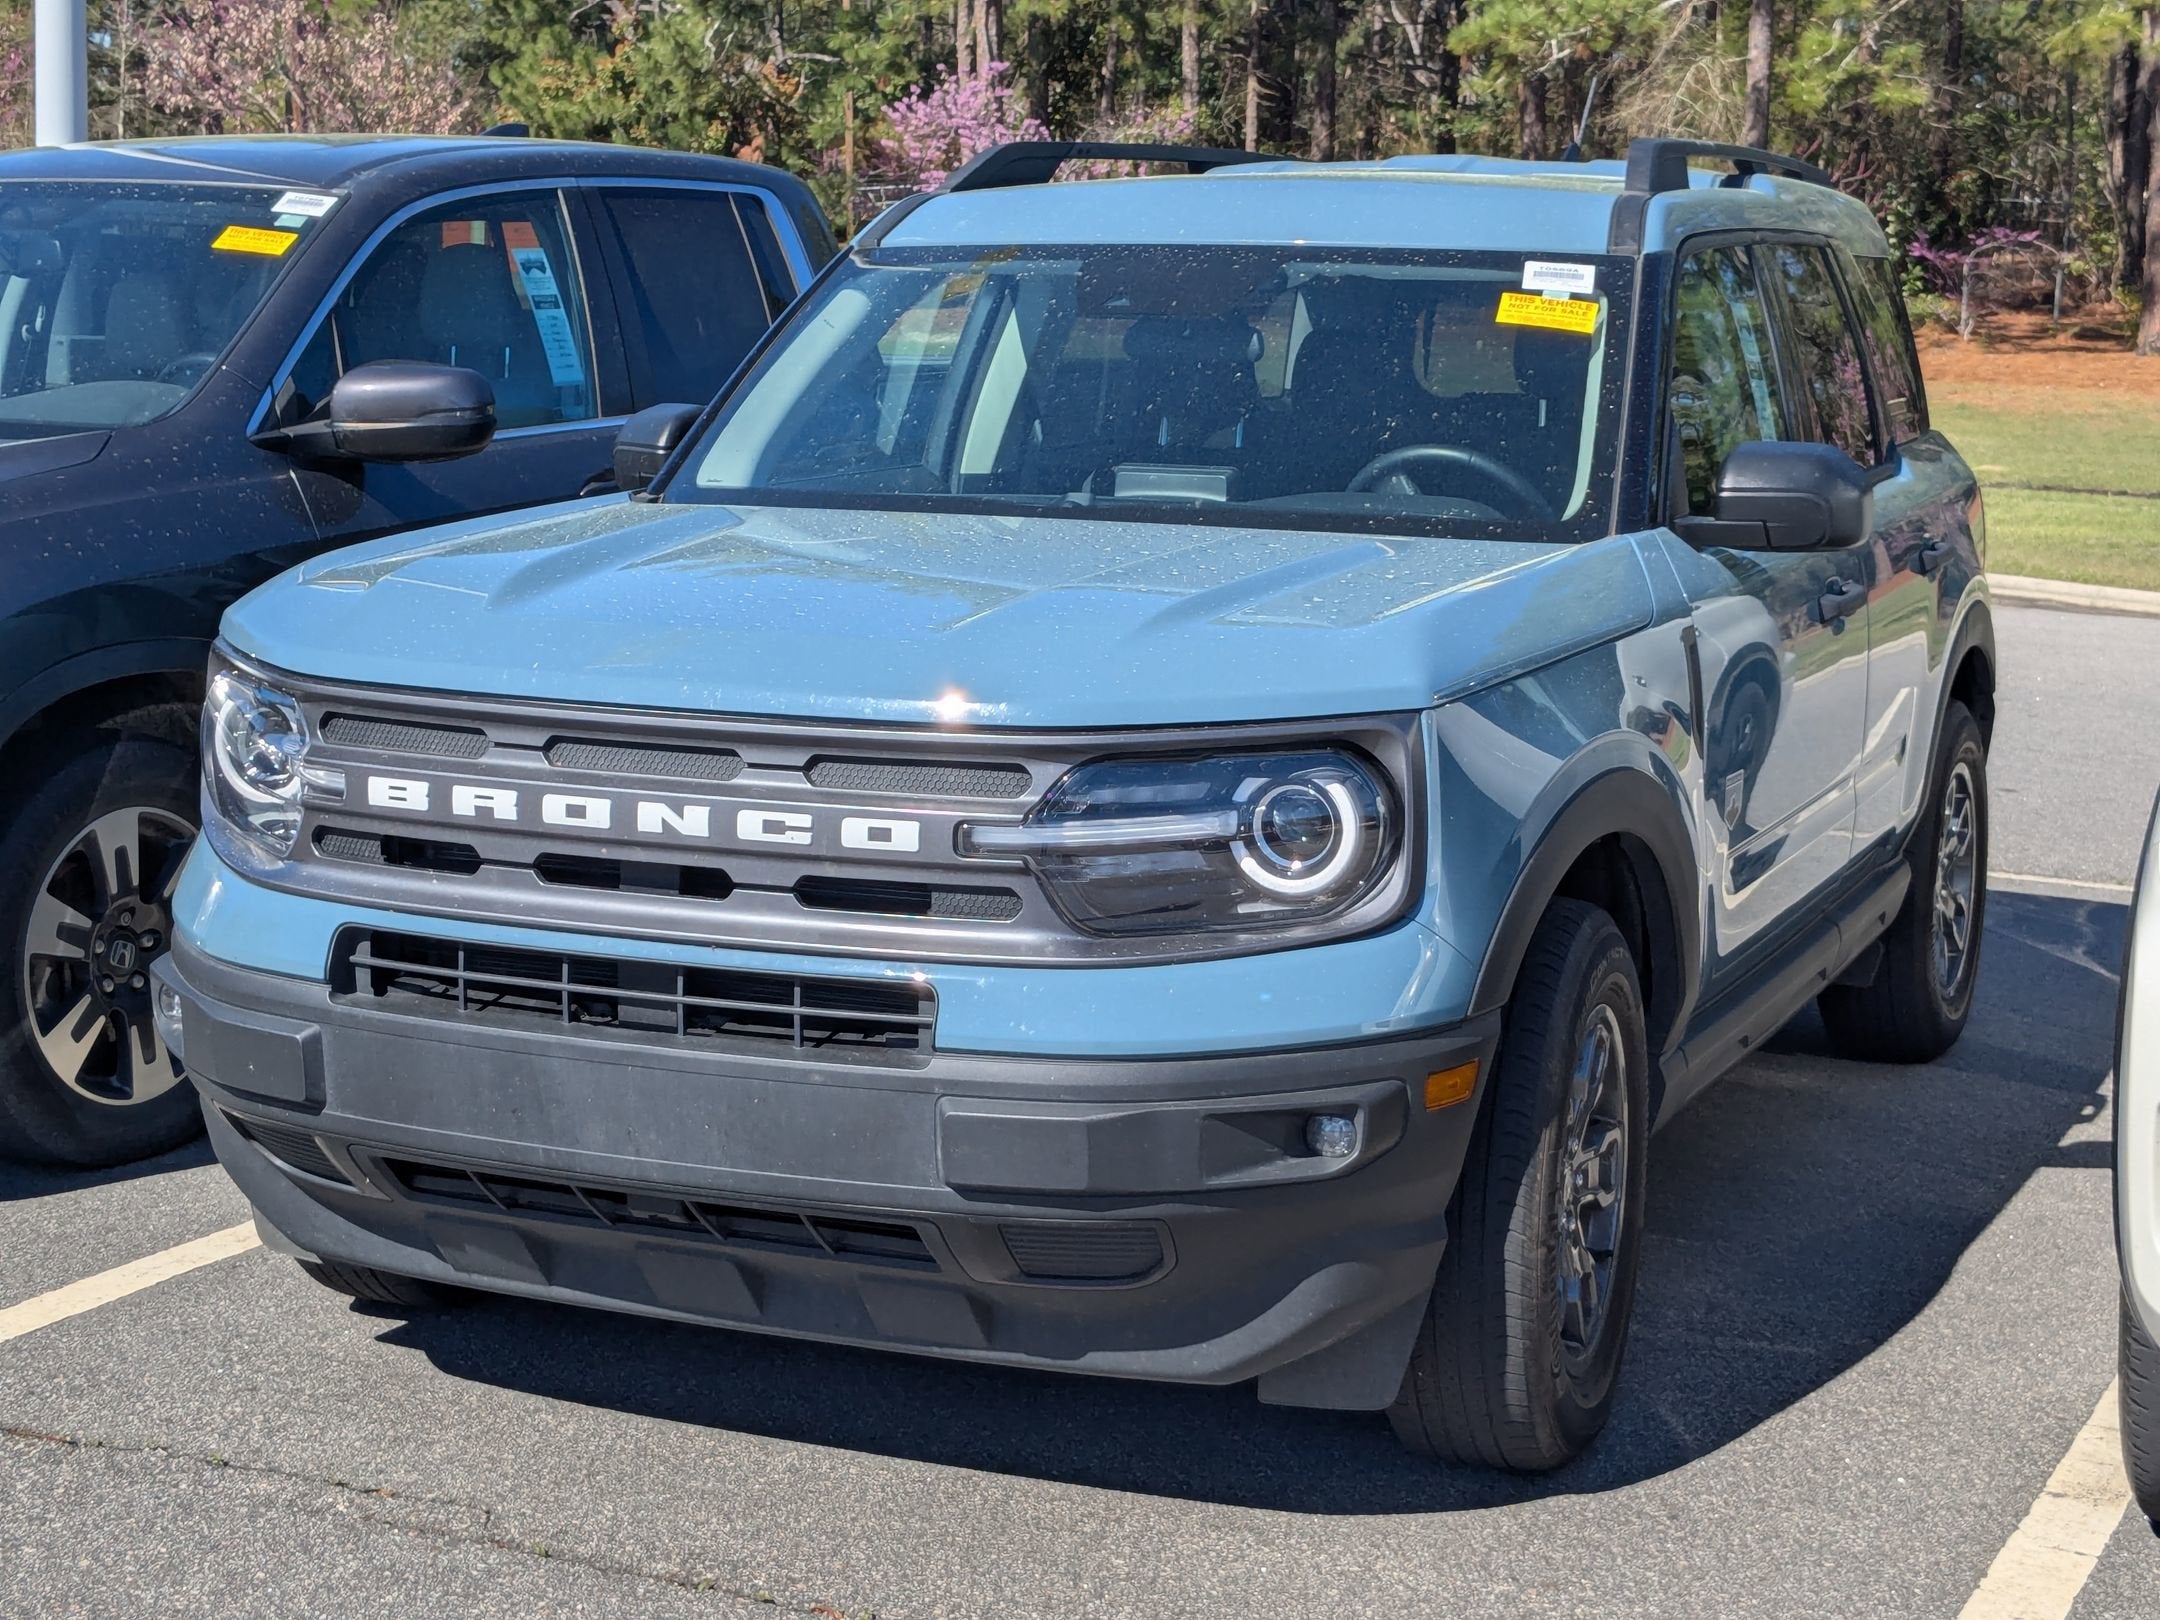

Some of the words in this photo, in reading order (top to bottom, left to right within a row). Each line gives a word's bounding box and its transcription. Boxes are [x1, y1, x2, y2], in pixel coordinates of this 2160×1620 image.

[1508, 294, 1537, 304] THIS
[1540, 296, 1594, 312] VEHICLE
[1508, 302, 1531, 311] NOT
[1534, 304, 1557, 313] FOR
[1561, 307, 1589, 317] SALE
[367, 775, 920, 853] BRONCO
